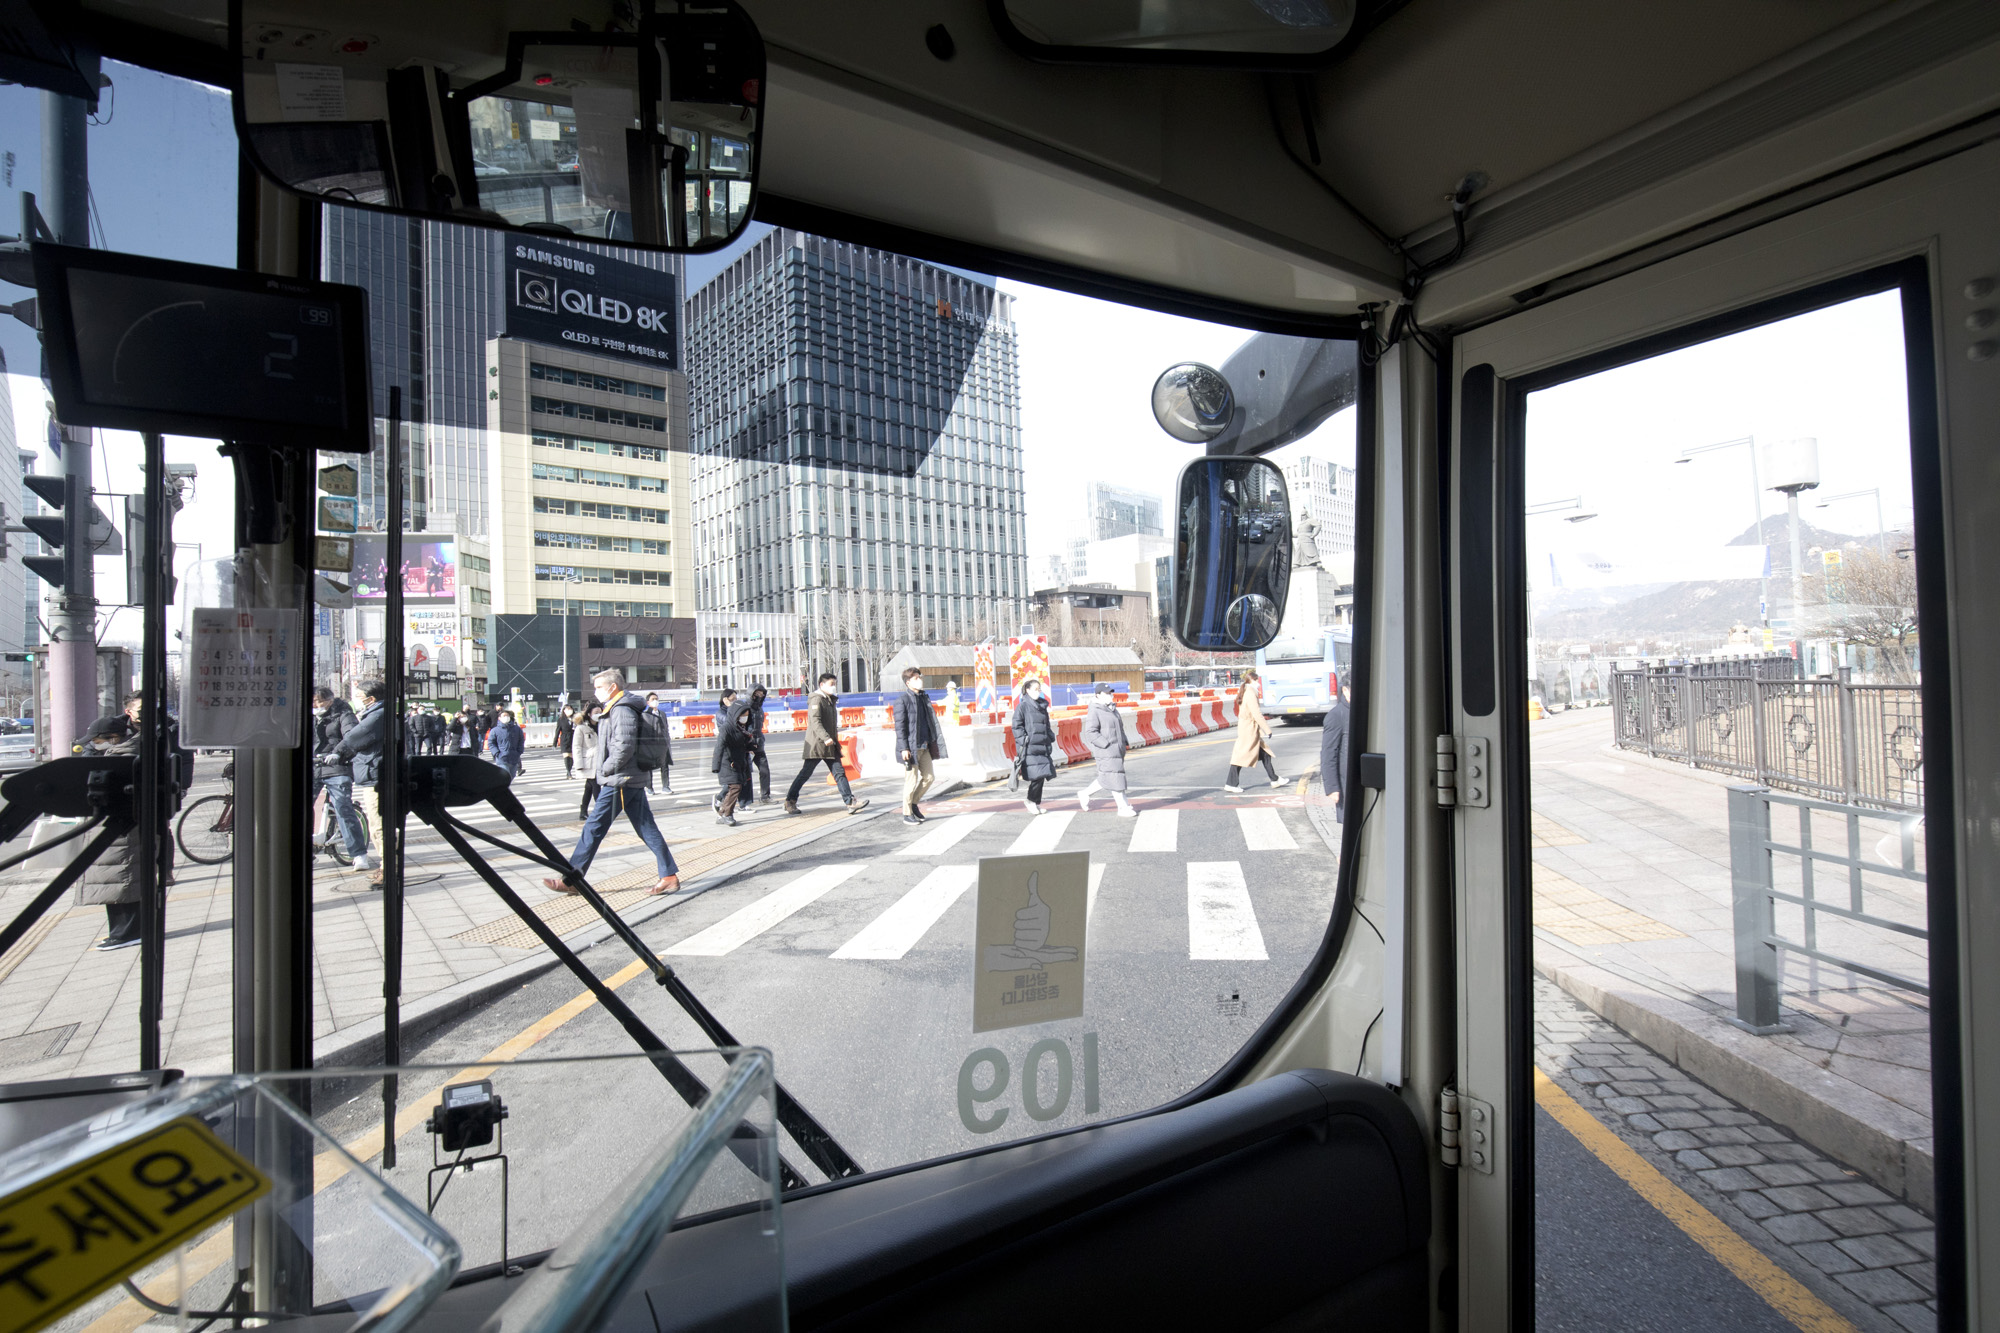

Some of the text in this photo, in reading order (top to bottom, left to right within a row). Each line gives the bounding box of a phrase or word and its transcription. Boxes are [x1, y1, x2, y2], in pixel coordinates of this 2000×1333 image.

[516, 245, 595, 276] SAMSUNG
[309, 309, 328, 323] 99
[561, 289, 669, 334] QLED 8K
[561, 330, 590, 344] QLED
[602, 338, 626, 351] 구현한
[658, 351, 669, 360] 8K
[264, 331, 298, 380] 2
[551, 566, 574, 575] 피부과
[267, 635, 286, 645] 1 2
[202, 651, 207, 660] 3
[214, 651, 220, 660] 4
[228, 651, 234, 660] 5
[254, 651, 260, 660] 7
[266, 651, 272, 660] 8
[280, 651, 286, 660] 9
[200, 666, 209, 676] 10
[213, 666, 221, 676] 11
[225, 666, 235, 676] 12
[265, 666, 274, 676] 15
[278, 666, 287, 676] 16
[199, 682, 287, 691] 17 18 19 20 21 22 23
[210, 697, 221, 706] 25
[223, 697, 234, 706] 26
[236, 697, 247, 706] 27
[250, 697, 260, 706] 28
[263, 697, 273, 706] 29
[277, 697, 287, 706] 30
